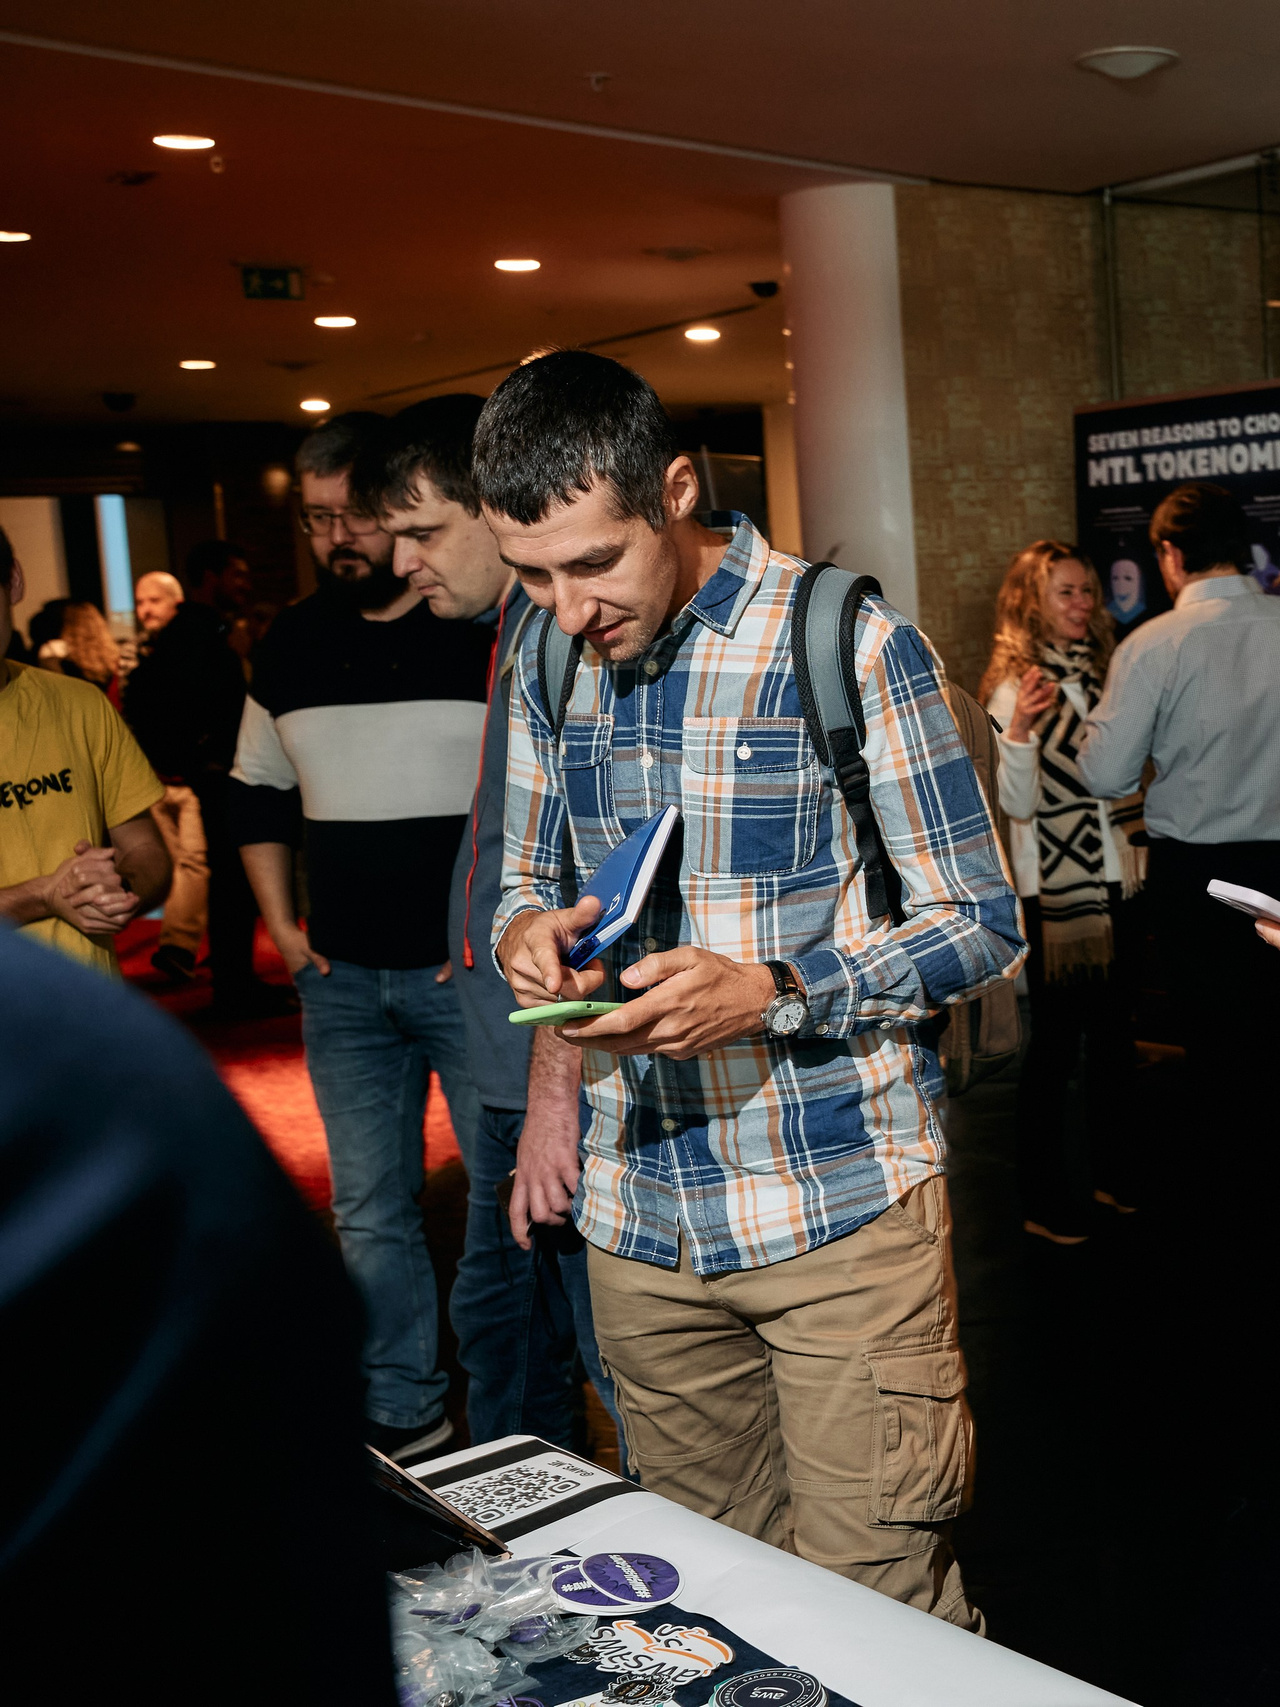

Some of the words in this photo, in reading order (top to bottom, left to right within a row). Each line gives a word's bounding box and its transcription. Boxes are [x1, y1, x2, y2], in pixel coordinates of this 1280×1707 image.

[1088, 430, 1139, 453] SEVEN
[1141, 420, 1217, 446] REASONS
[1218, 416, 1240, 437] TO
[1088, 456, 1141, 487] MTL
[749, 1690, 786, 1700] aws
